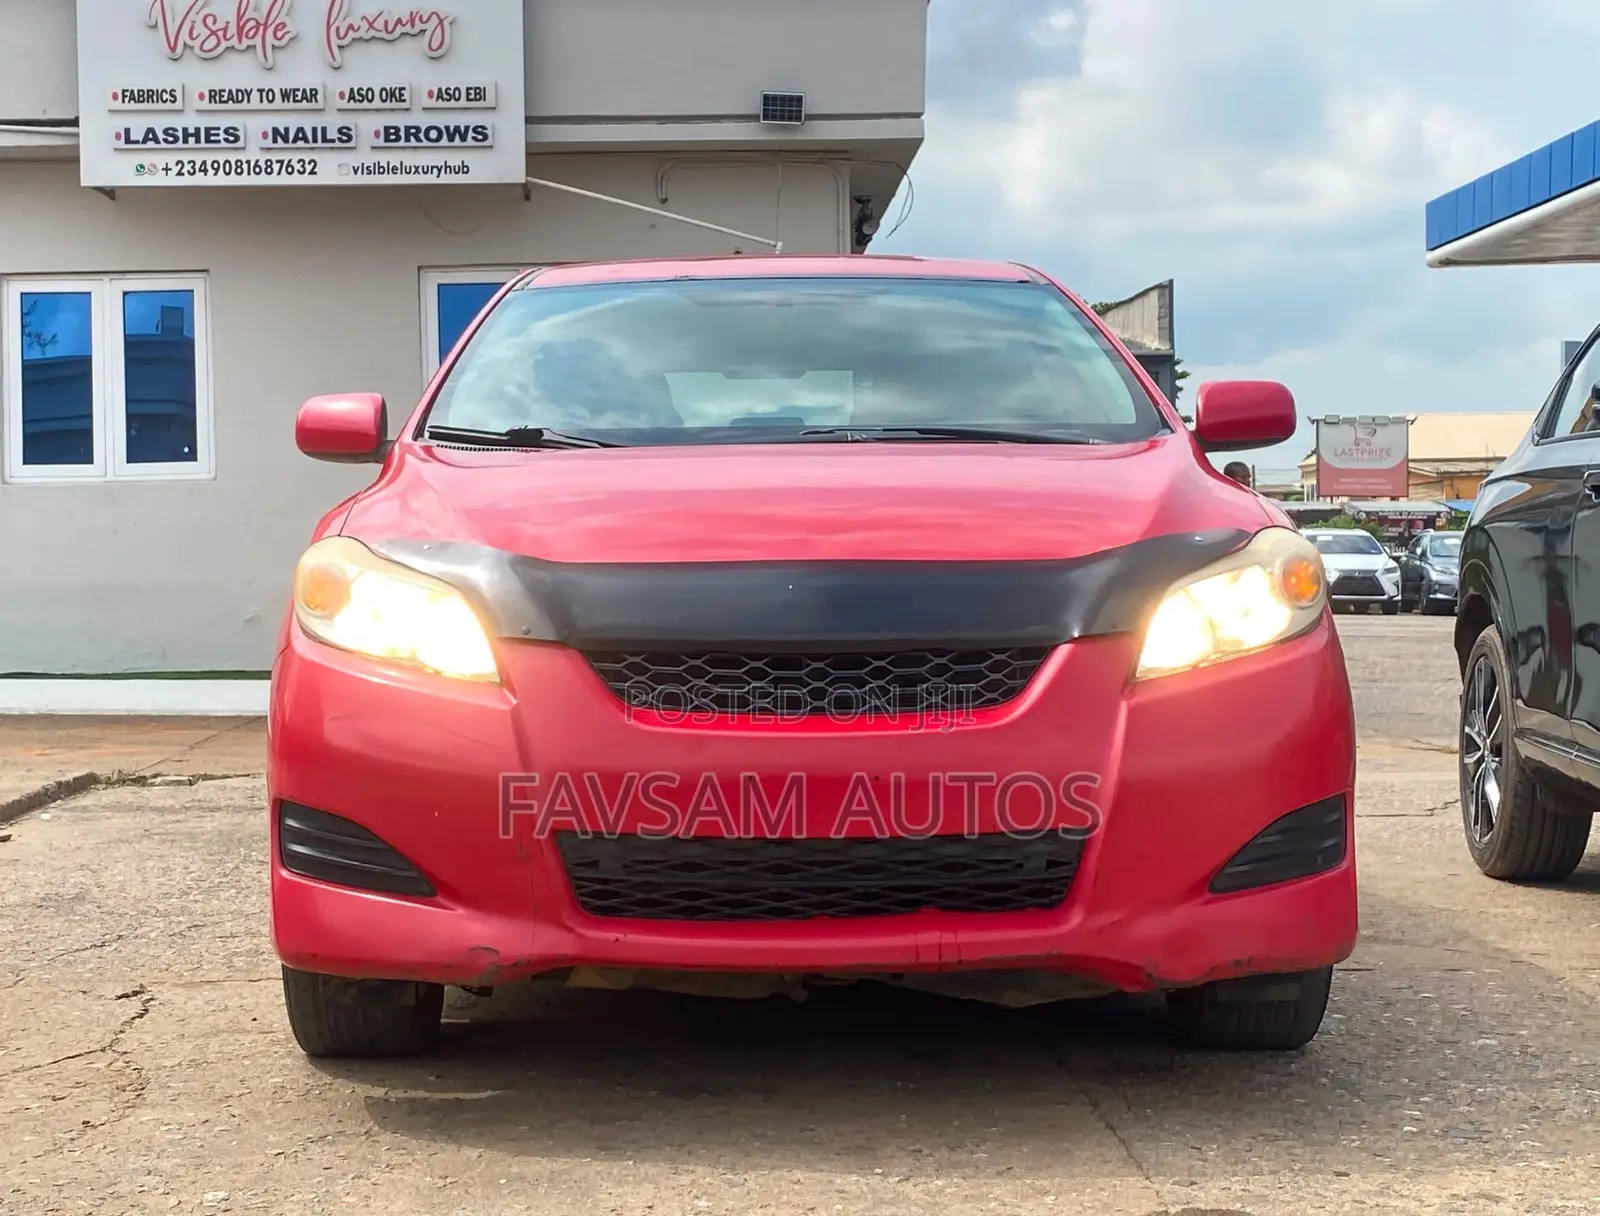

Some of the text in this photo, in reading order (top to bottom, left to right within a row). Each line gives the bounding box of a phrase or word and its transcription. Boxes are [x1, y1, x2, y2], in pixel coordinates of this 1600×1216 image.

[148, 0, 450, 62] Visible luxury
[121, 88, 177, 104] FABRICS
[208, 87, 319, 104] READY TO WEAR
[347, 87, 407, 103] ASO OKE
[436, 86, 487, 102] ASO EBI
[124, 127, 241, 145] LASHES
[272, 126, 353, 144] NAILS
[383, 125, 489, 143] BROWS
[162, 159, 318, 177] +2349081687632
[352, 161, 470, 178] visibleluxuryhub
[1333, 447, 1392, 458] LASTPRIZE
